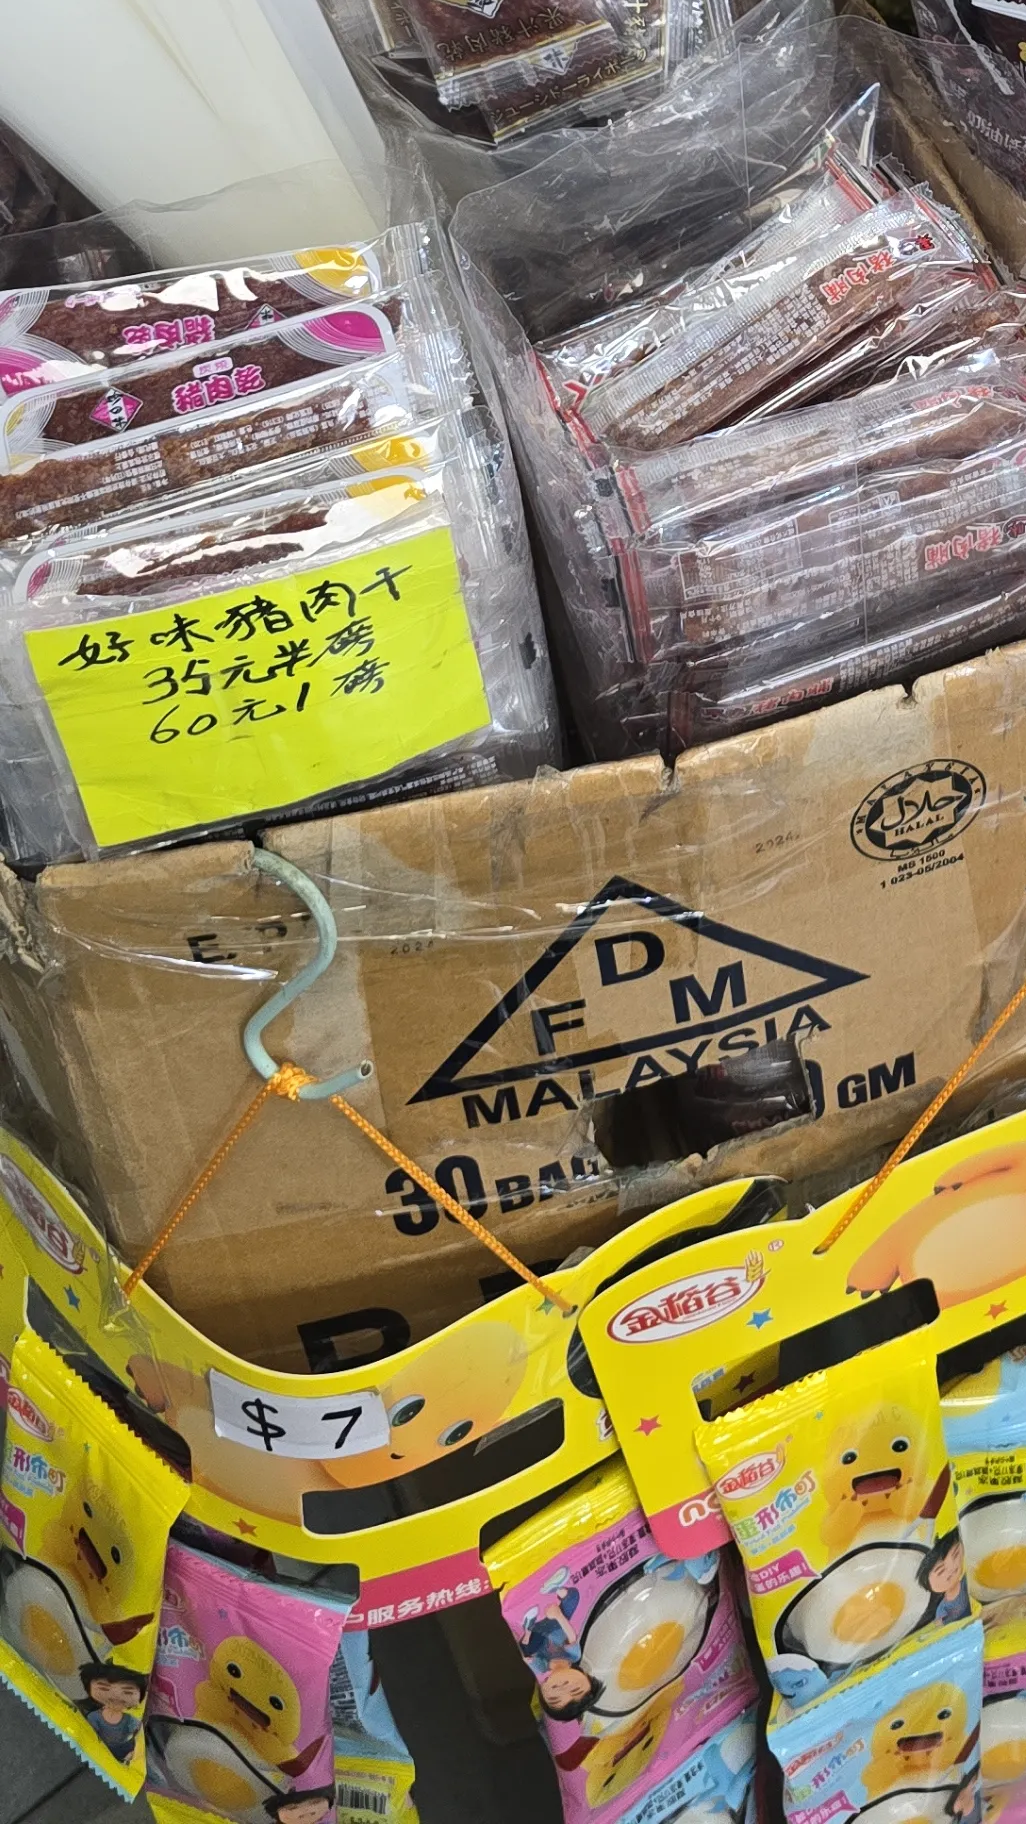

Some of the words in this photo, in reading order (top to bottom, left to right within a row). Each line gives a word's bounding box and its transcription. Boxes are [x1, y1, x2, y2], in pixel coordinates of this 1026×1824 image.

[436, 7, 566, 61] 果汁豬肉乾
[171, 363, 267, 414] 豬肉乾
[57, 564, 413, 672] 好味豬肉干
[142, 616, 376, 706] 35元半磅
[149, 658, 390, 745] 60元1磅
[855, 762, 980, 826] MALAYSIA
[893, 813, 945, 837] HALAL
[918, 849, 946, 866] 1500
[594, 929, 667, 987] D
[529, 998, 588, 1058] F
[668, 961, 750, 1025] M
[461, 1002, 833, 1131] MALAYSIA
[836, 1052, 918, 1111] GM
[383, 1153, 487, 1237] 30
[240, 1397, 286, 1452] $
[321, 1406, 364, 1449] 7
[734, 1470, 818, 1540] 蛋形布丁
